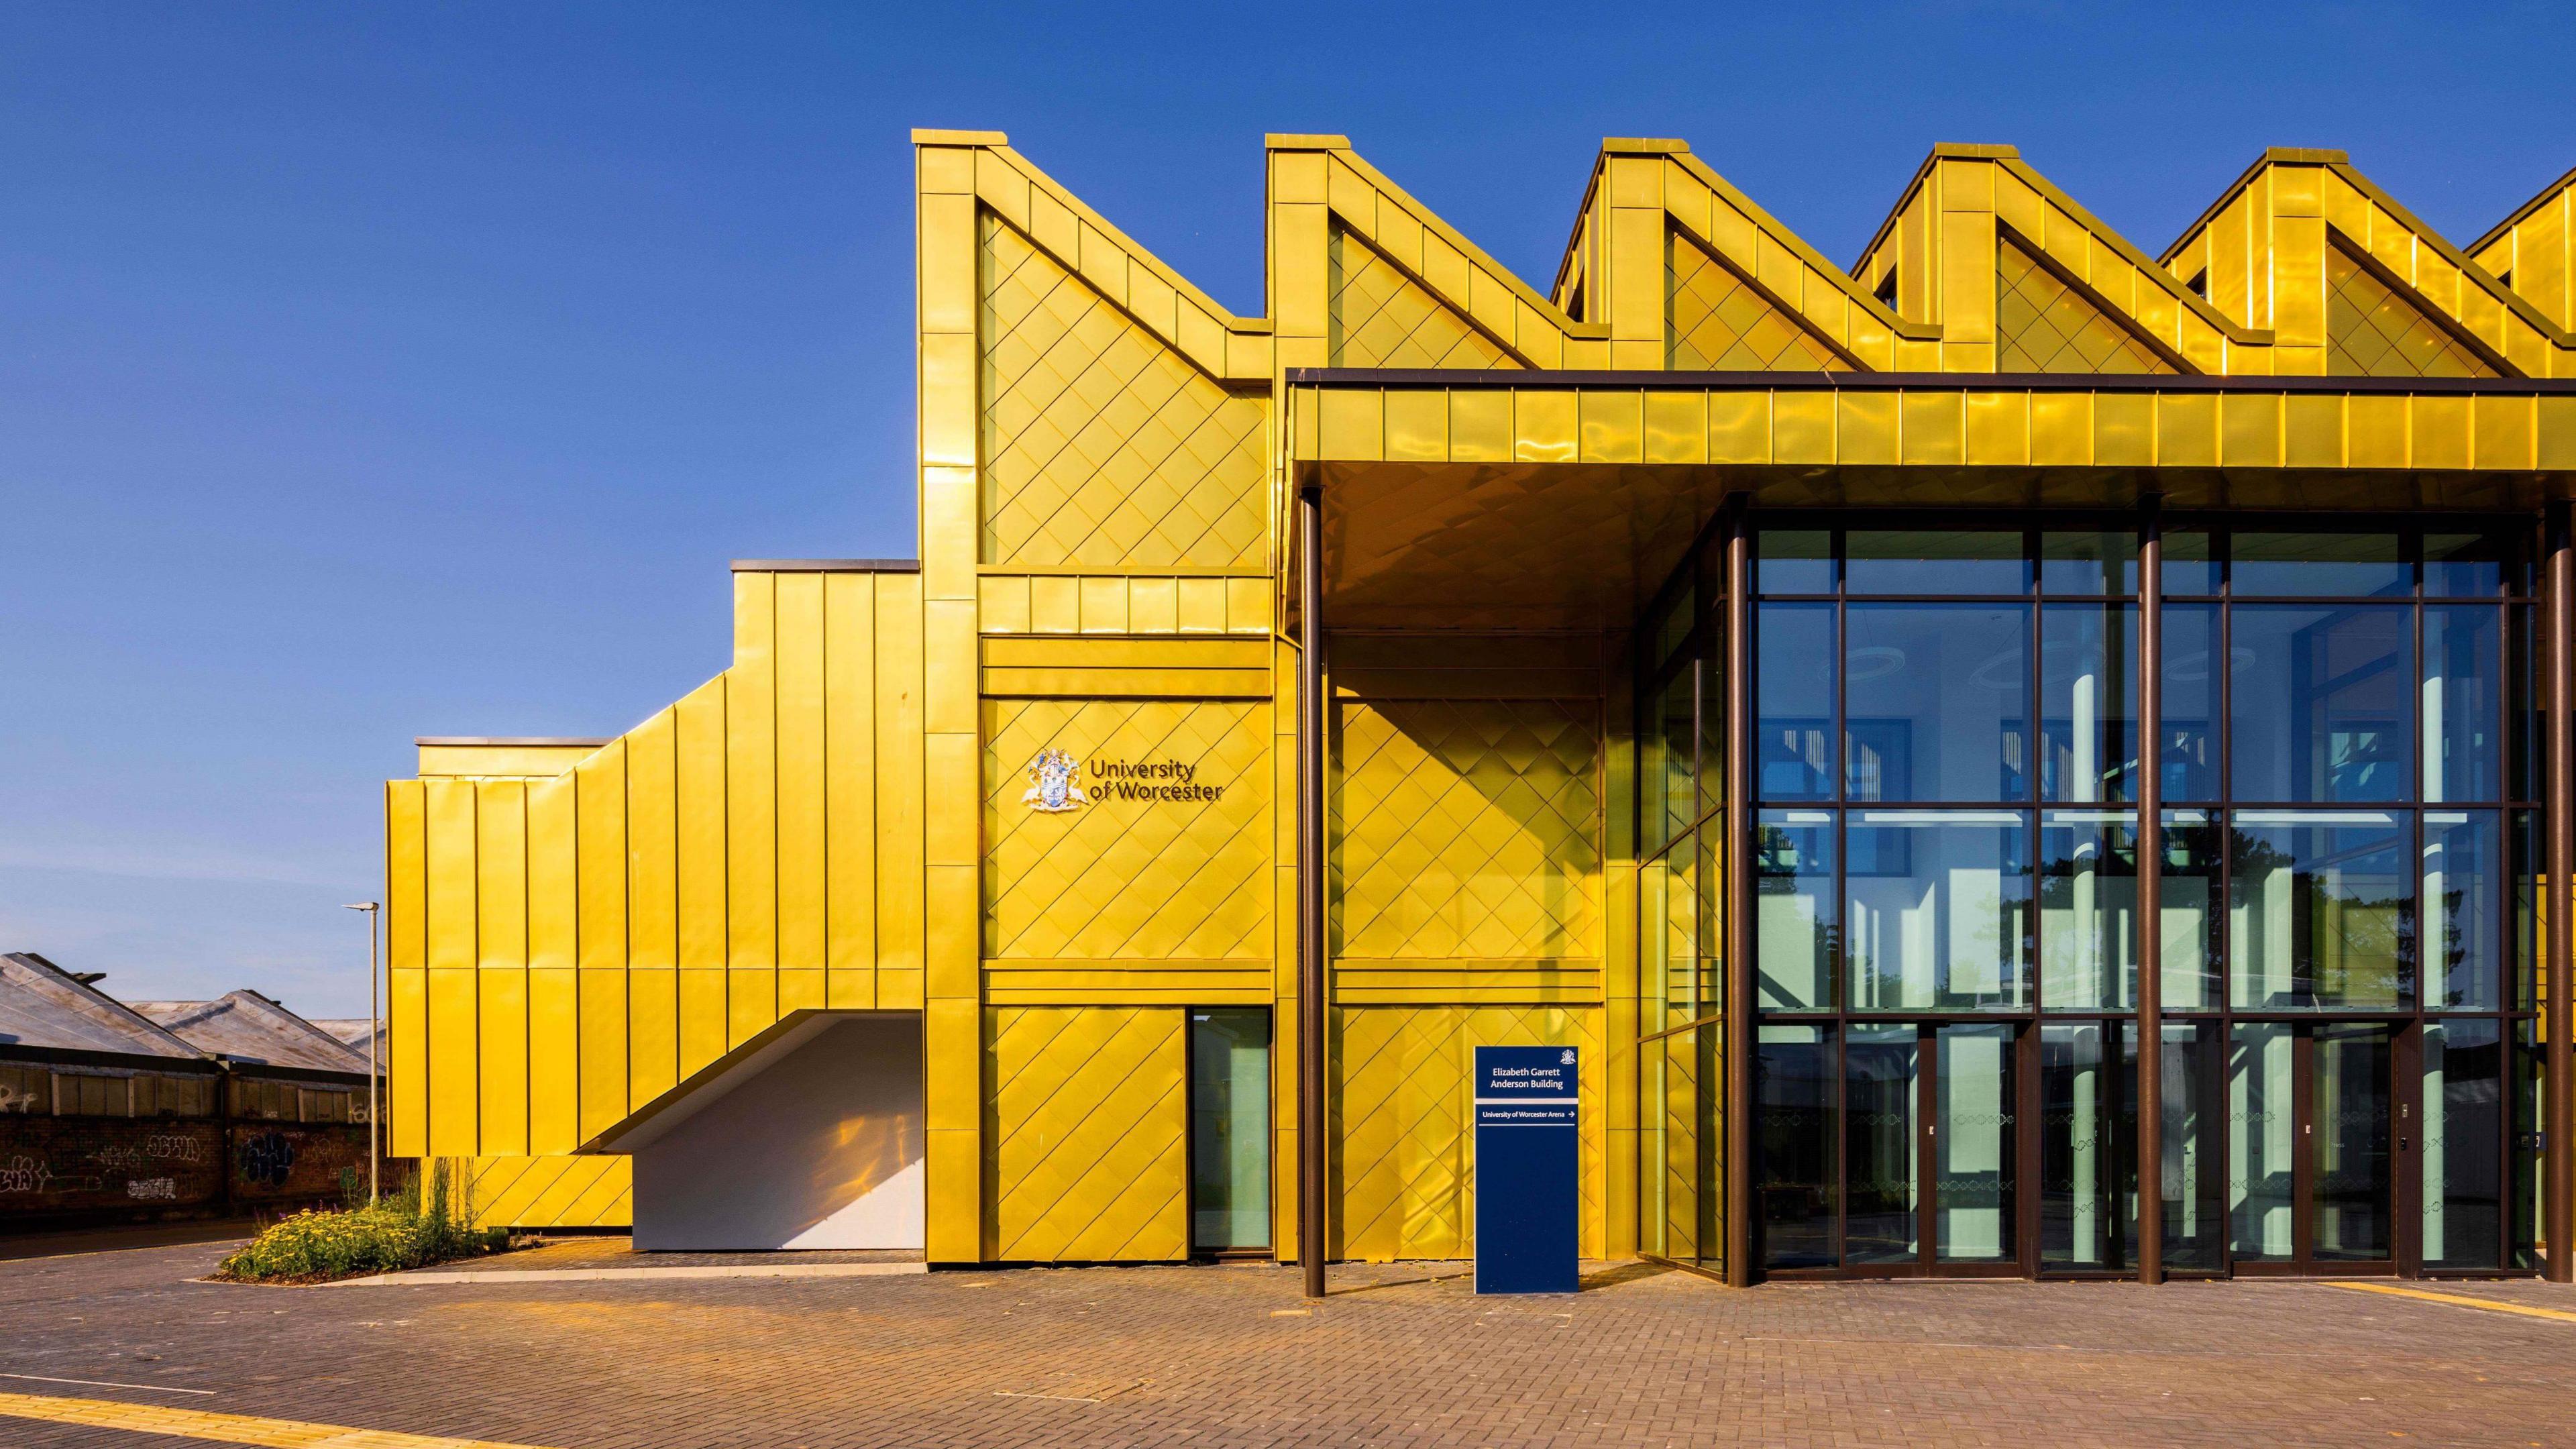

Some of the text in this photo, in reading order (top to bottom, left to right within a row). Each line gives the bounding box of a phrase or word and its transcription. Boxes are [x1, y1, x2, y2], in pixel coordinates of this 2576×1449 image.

[1090, 758, 1195, 783] University
[1089, 781, 1223, 800] of Worcester
[1493, 1068, 1560, 1076] Elizabeth Garrett
[1491, 1079, 1564, 1090] Anderson Building
[1483, 1111, 1511, 1119] University
